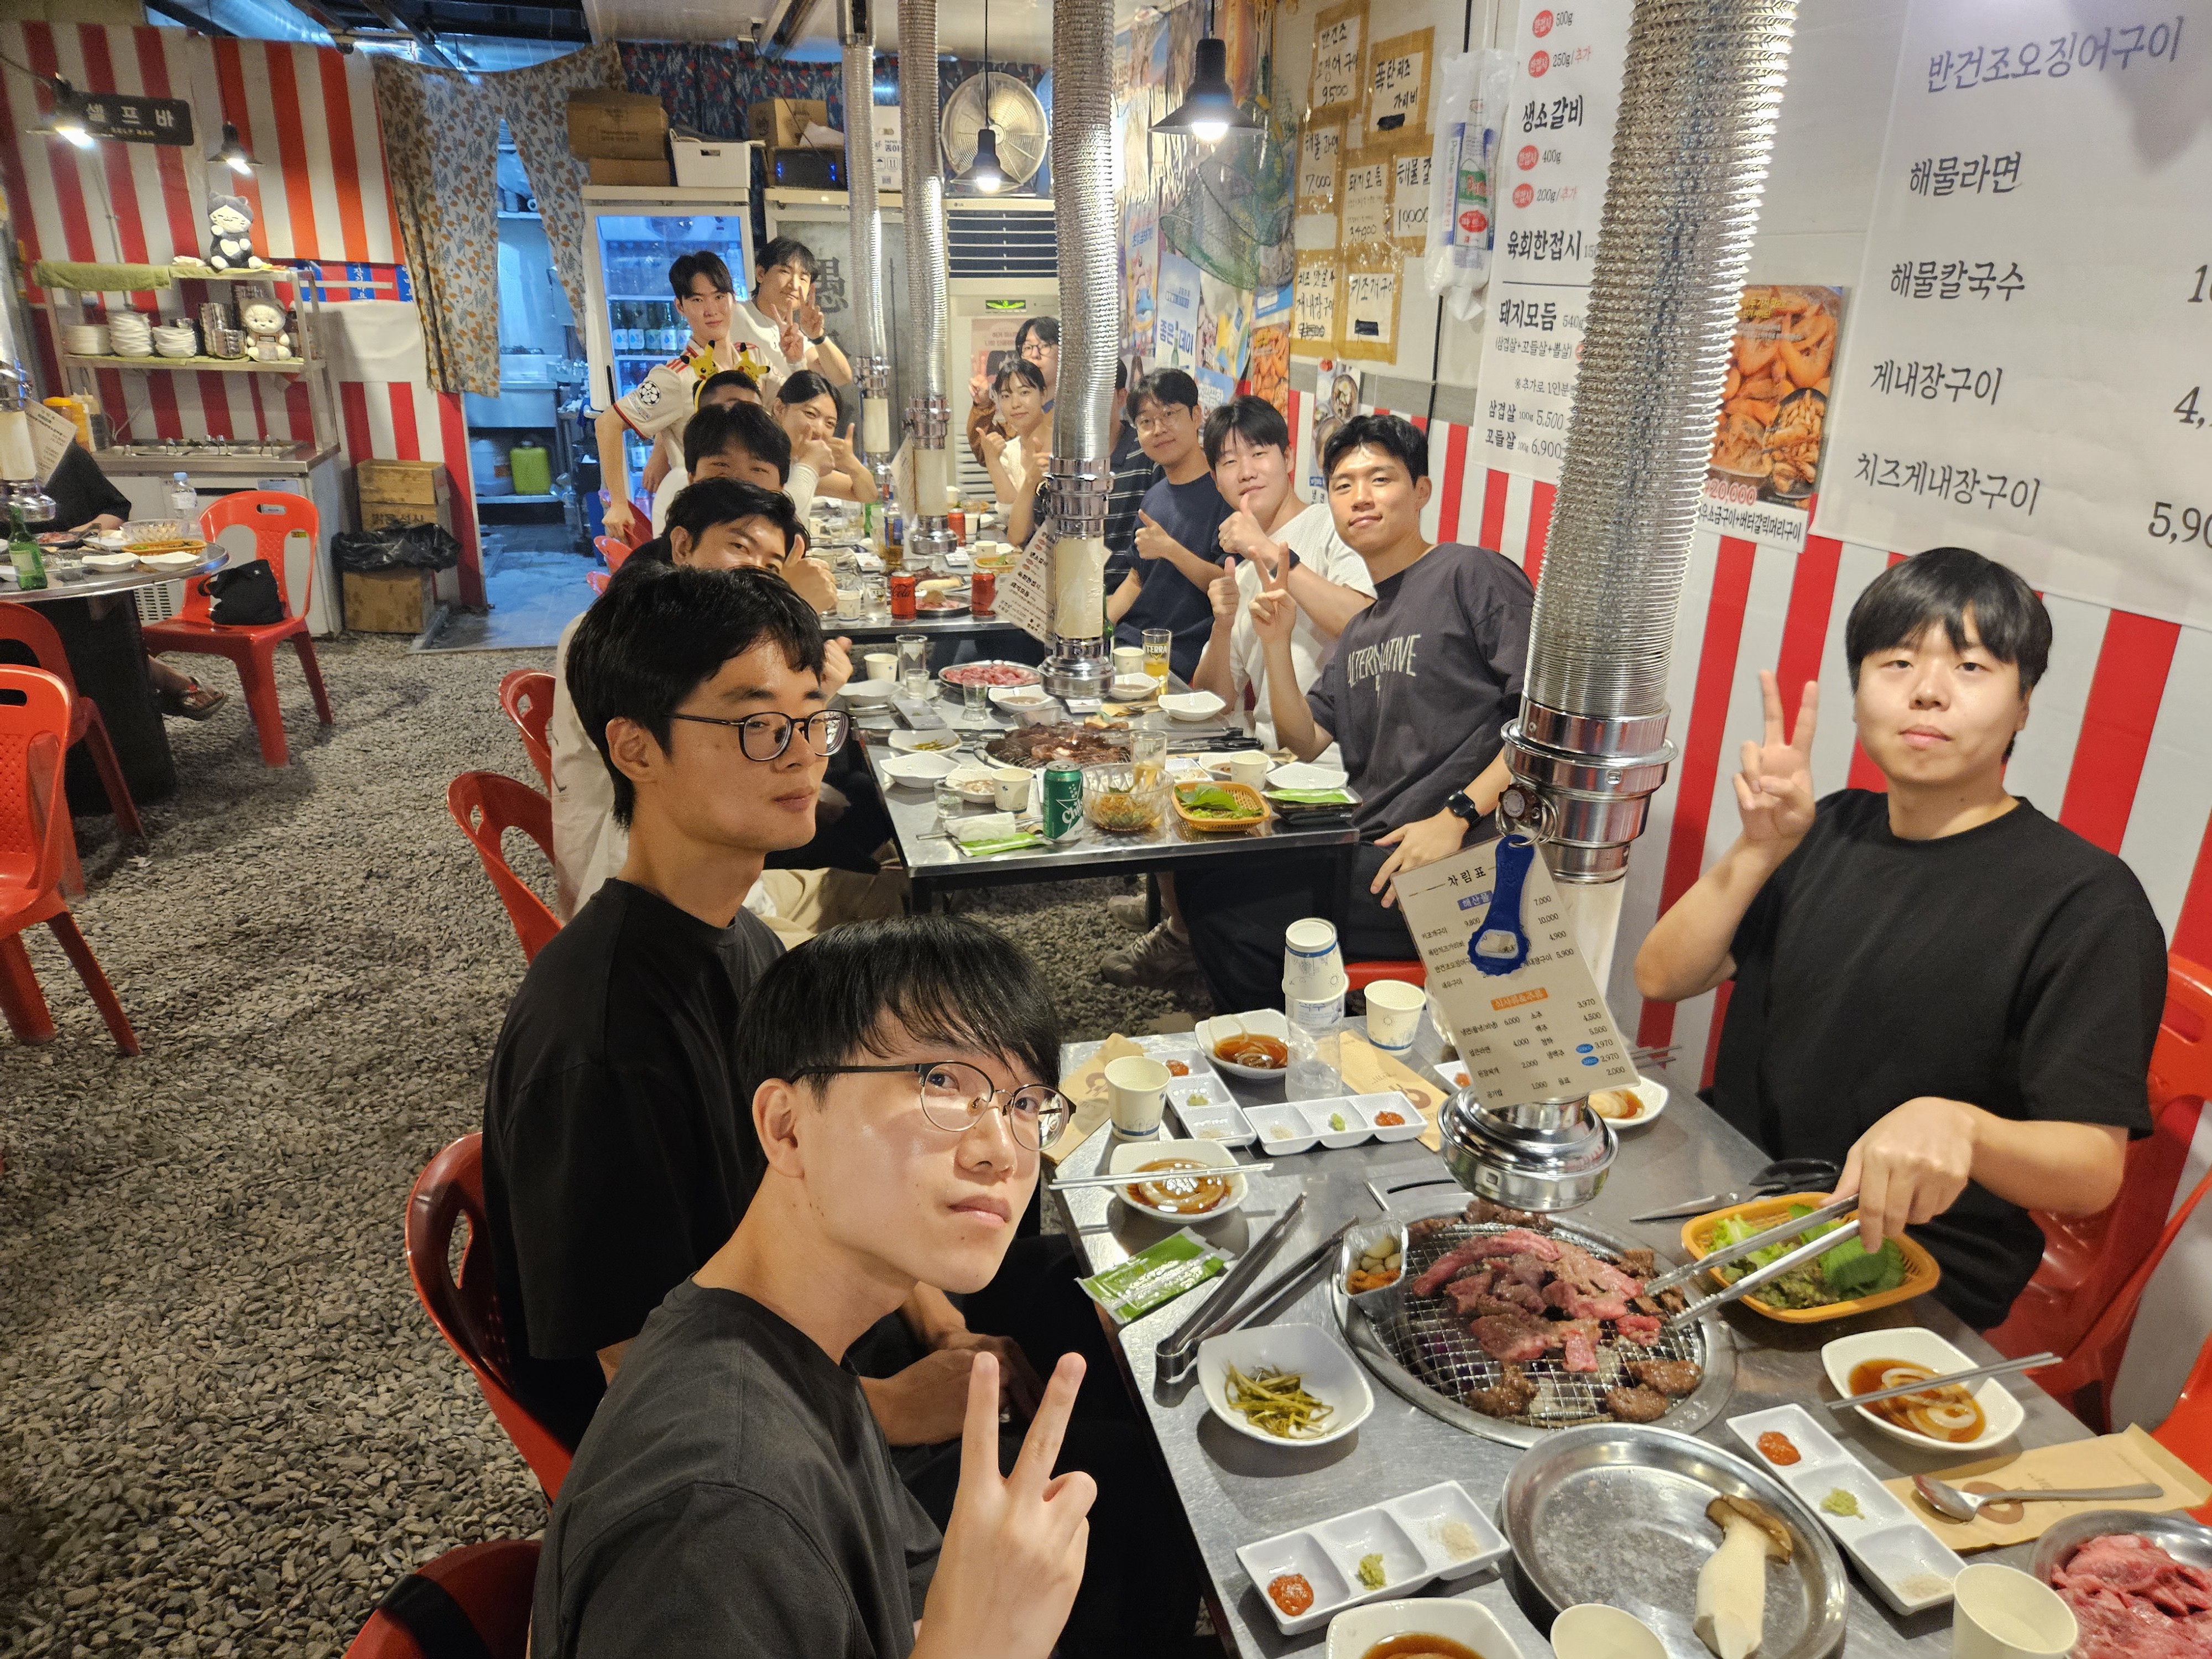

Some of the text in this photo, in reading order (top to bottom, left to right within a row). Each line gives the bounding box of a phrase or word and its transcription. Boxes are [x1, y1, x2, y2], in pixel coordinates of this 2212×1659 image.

[1556, 11, 1573, 27] 500g
[1928, 15, 2184, 93] 반건조오징어구이
[1394, 87, 1418, 109] 가리비
[1522, 95, 1583, 133] 생소갈비
[1542, 150, 1561, 164] 400g
[1910, 151, 2022, 196] 해물라면
[1507, 230, 1582, 261] 육회한접시
[1890, 260, 2212, 303] 해물칼국수 1
[1499, 299, 1584, 332] 돼지모듬 540g
[1870, 359, 2212, 430] 게내장구이 4,
[1489, 400, 1516, 423] 삼겹살
[1536, 409, 1564, 430] 5,500
[1485, 428, 1516, 450] 꼬들살
[1531, 438, 1562, 459] 6,900
[1854, 453, 2041, 517] 치즈게내장구이
[1698, 503, 1802, 543] 우소금구이+버터갈릭머리구이
[1146, 645, 1167, 654] TERRA
[1347, 634, 1421, 688] ALTERNATIVE
[1447, 866, 1486, 887] 차림표
[1462, 892, 1493, 908] 해산물
[1533, 895, 1552, 906] 7,000
[1537, 912, 1559, 925] 10,000
[1421, 926, 1448, 940] 키조개구이
[1549, 930, 1566, 941] 4,900
[1434, 957, 1471, 973] 반건조오징어구
[1523, 953, 1553, 968] 게내장구이
[1442, 978, 1463, 989] 새우구이
[1531, 998, 1596, 1020] 소주 3,970
[1504, 1016, 1520, 1026] 6,000
[1535, 1011, 1601, 1032] 맥주 4,500
[1588, 1025, 1608, 1036] 5,500
[1513, 1037, 1530, 1047] 4,000
[1521, 1059, 1538, 1069] 2,000
[1600, 1052, 1619, 1063] 2,970
[1606, 1066, 1625, 1076] 2,000
[1486, 1088, 1504, 1098] 공기밥
